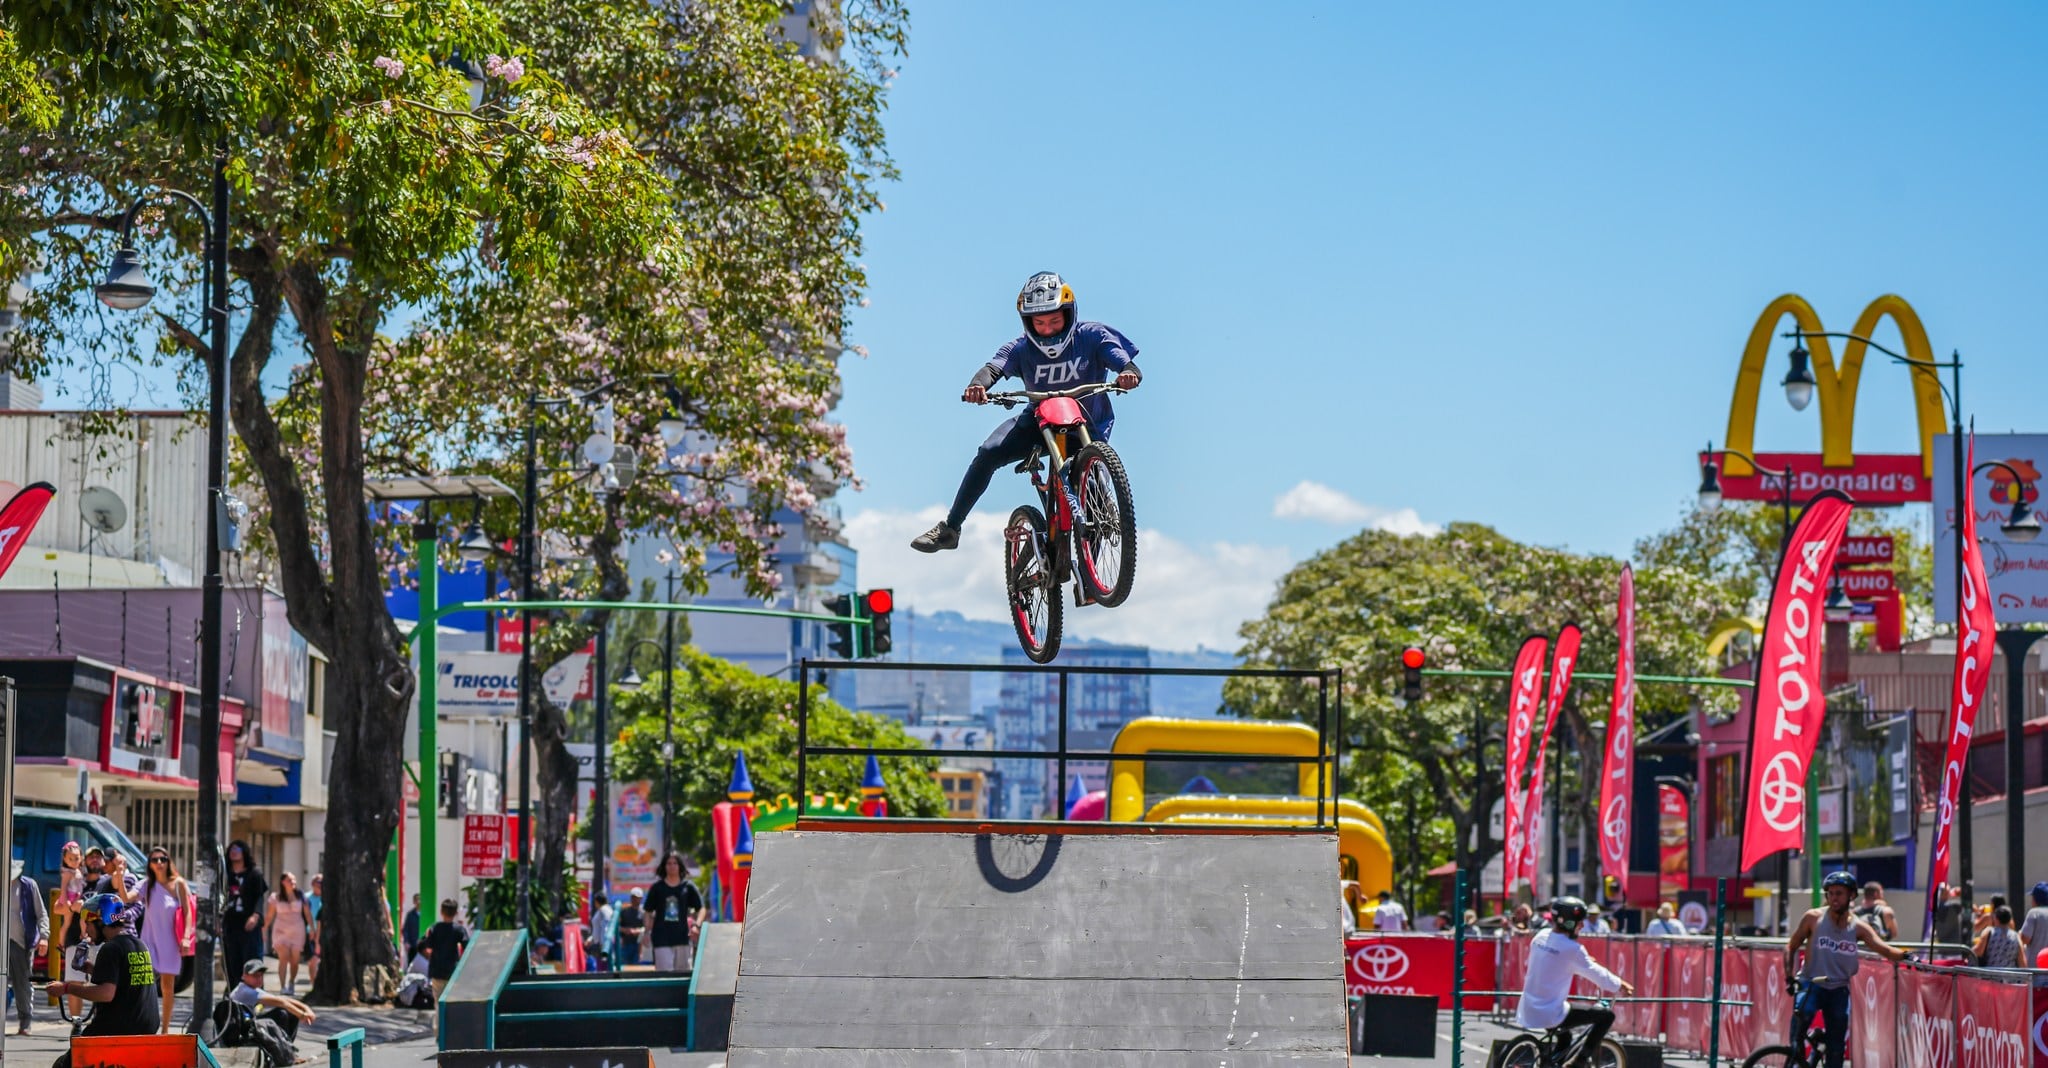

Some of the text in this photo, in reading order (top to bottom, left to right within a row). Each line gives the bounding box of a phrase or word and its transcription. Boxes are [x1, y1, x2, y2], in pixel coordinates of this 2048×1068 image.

[1034, 357, 1081, 385] FOX
[1760, 472, 1916, 492] McDonald's
[1773, 539, 1827, 741] TOYOTA
[453, 675, 519, 688] TRICOLO
[477, 688, 521, 699] Car Ren
[482, 815, 500, 828] SOLO
[469, 830, 499, 842] SENTIDO
[1347, 984, 1415, 997] TOYOTA
